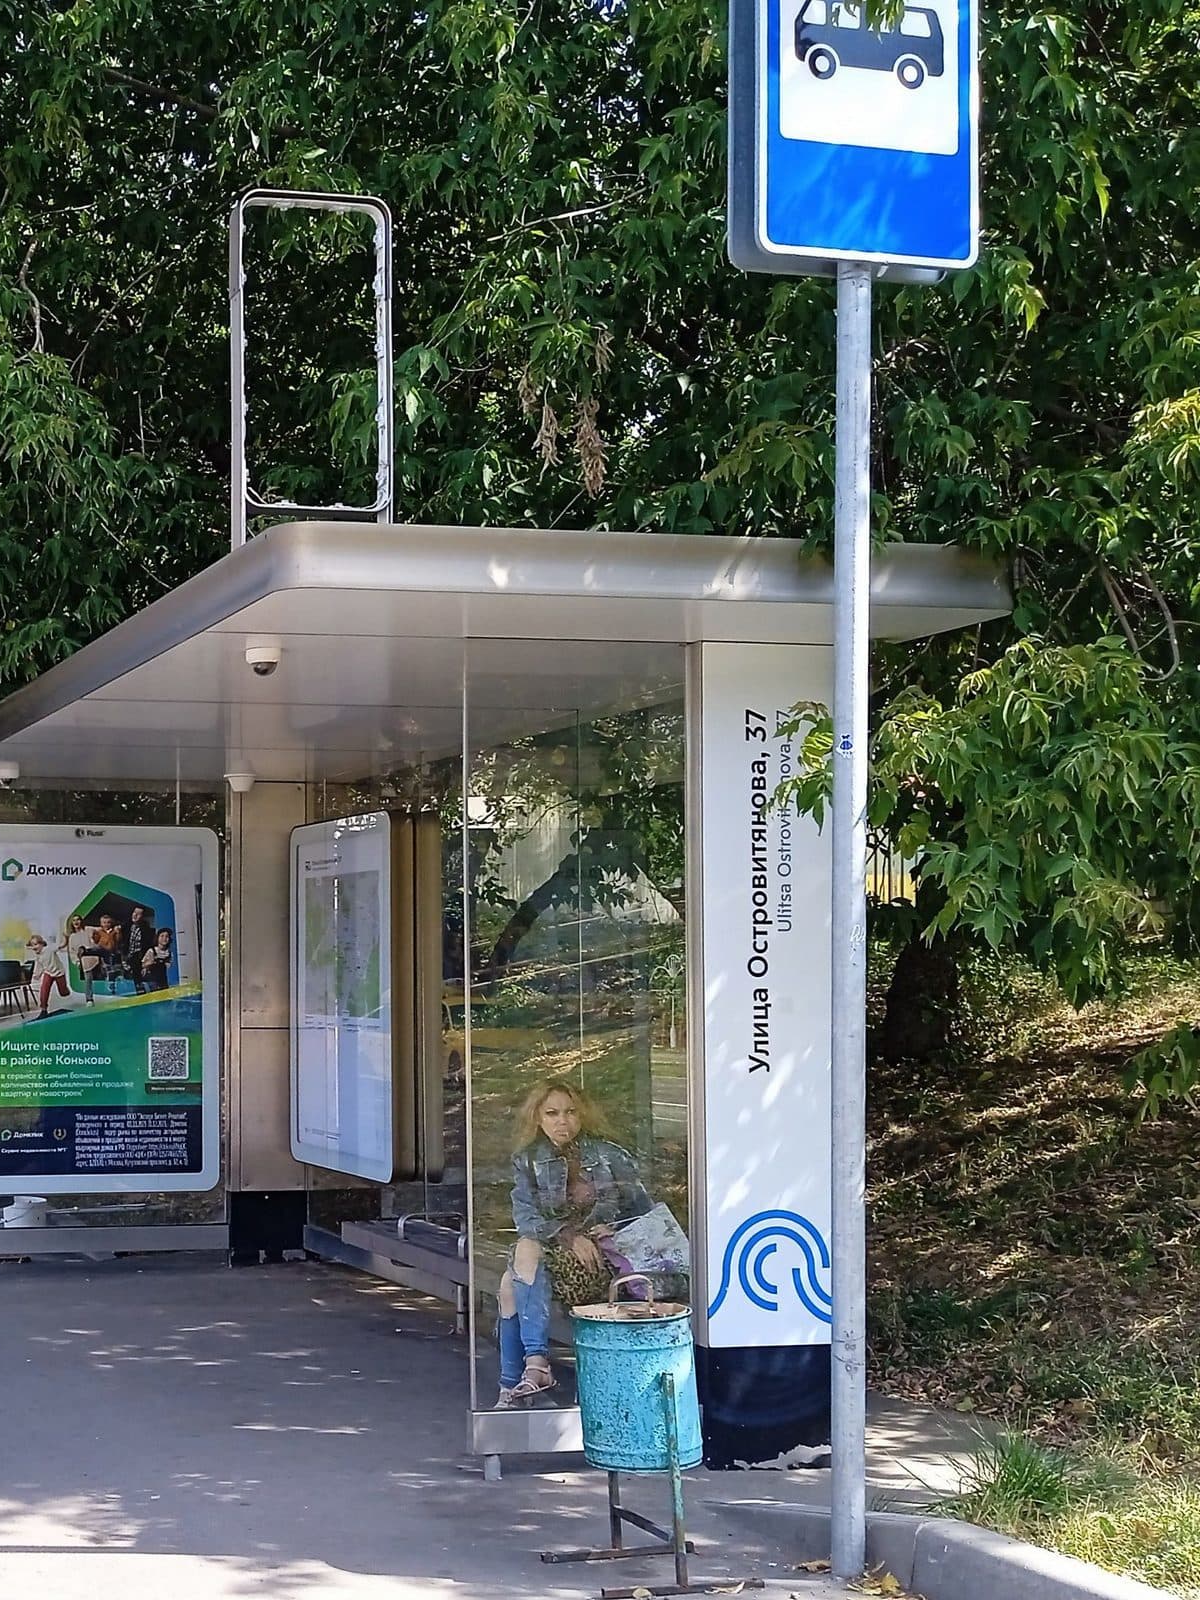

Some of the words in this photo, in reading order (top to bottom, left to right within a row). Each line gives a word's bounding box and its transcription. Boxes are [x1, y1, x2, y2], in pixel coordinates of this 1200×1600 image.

[745, 709, 767, 742] 37
[26, 864, 87, 876] Домклик
[747, 752, 773, 978] Островитянова,
[777, 883, 792, 932] Ulitsa
[0, 1041, 40, 1052] Ищите
[43, 1042, 99, 1053] квартиры
[748, 988, 772, 1073] Улица
[0, 1057, 7, 1065] в
[10, 1054, 53, 1067] районе
[55, 1054, 112, 1065] Коньково
